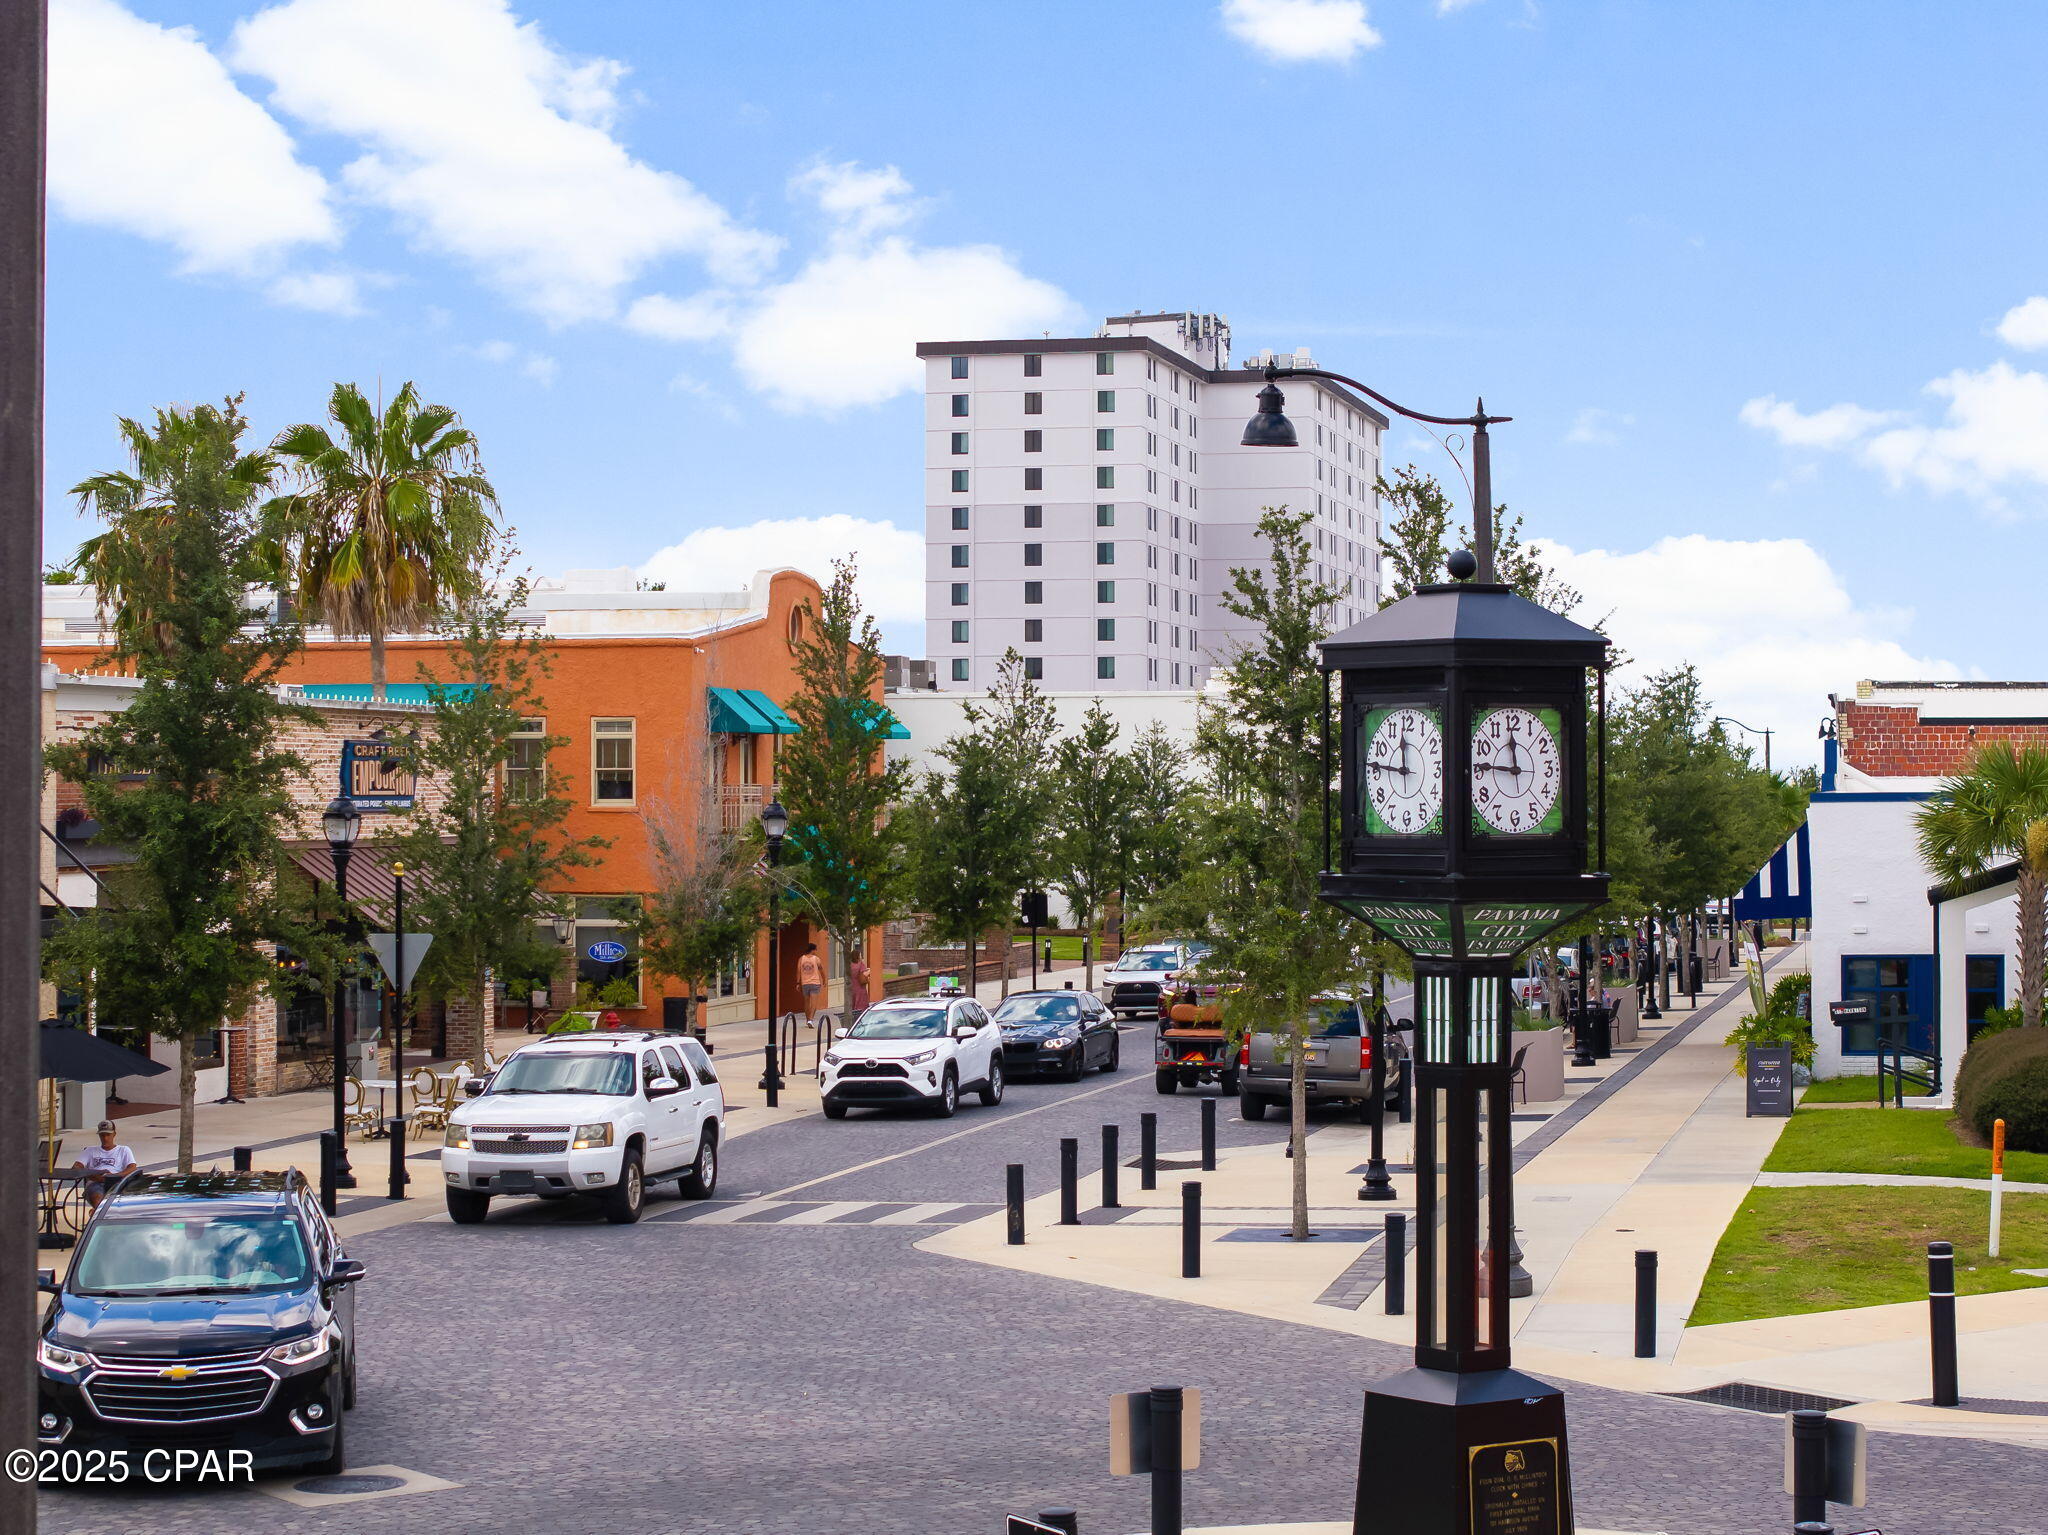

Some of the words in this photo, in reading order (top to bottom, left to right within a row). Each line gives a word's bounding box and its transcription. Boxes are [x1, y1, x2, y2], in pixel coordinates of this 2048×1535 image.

[1388, 722, 1398, 739] 11
[1401, 714, 1415, 732] 12
[1420, 720, 1426, 738] 1
[1490, 720, 1501, 739] 11
[1506, 714, 1521, 732] 12
[1527, 719, 1533, 737] 1
[354, 745, 385, 756] CRAFT
[1375, 740, 1388, 758] 10
[1430, 737, 1439, 755] 2
[1476, 739, 1491, 756] 10
[1538, 736, 1550, 754] 2
[1433, 760, 1442, 779] 3
[1544, 760, 1554, 778] 3
[1376, 786, 1386, 804] 8
[1430, 782, 1439, 800] 4
[1478, 786, 1490, 804] 8
[1540, 782, 1551, 800] 4
[1388, 804, 1397, 822] 7
[1402, 810, 1412, 828] 6
[1418, 802, 1428, 821] 5
[1492, 804, 1502, 822] 7
[1510, 809, 1520, 828] 6
[1528, 802, 1539, 820] 5
[1361, 906, 1442, 920] PANAMA
[1473, 908, 1561, 921] PANAMA
[1394, 923, 1436, 938] CITY
[1482, 924, 1532, 938] CITY
